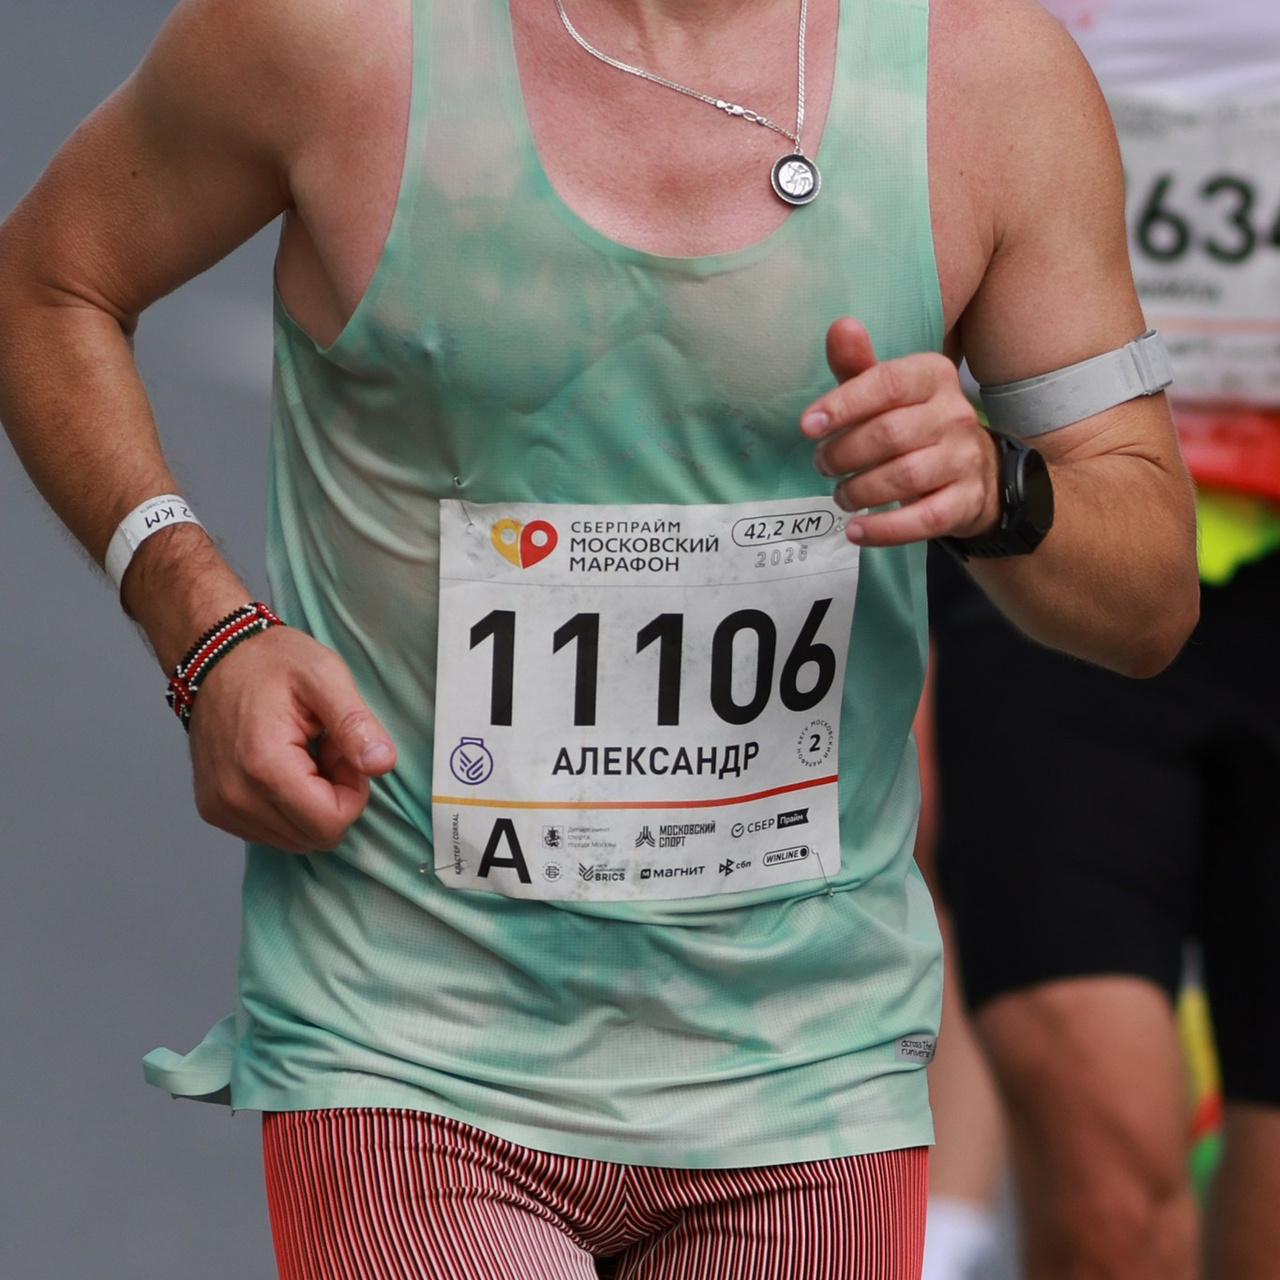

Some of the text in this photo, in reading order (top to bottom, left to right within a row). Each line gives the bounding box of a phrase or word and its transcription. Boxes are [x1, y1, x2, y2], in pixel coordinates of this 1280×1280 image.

[571, 519, 681, 534] СБЕРПРАЙМ
[744, 516, 822, 540] 42,2 КМ
[570, 534, 719, 553] МОСКОВСКИЙ
[569, 556, 680, 572] МАРАФОН
[469, 597, 836, 726] 11106
[809, 733, 821, 753] 2
[551, 741, 760, 780] АЛЕКСАНДР
[659, 820, 716, 836] МОСКОВСКИЙ
[747, 811, 805, 833] СБЕР Прайм
[659, 836, 686, 848] СПОРТ
[766, 849, 799, 864] WINLINE
[653, 865, 706, 879] магнит
[736, 860, 752, 870] сбп
[595, 871, 625, 882] BRICS
